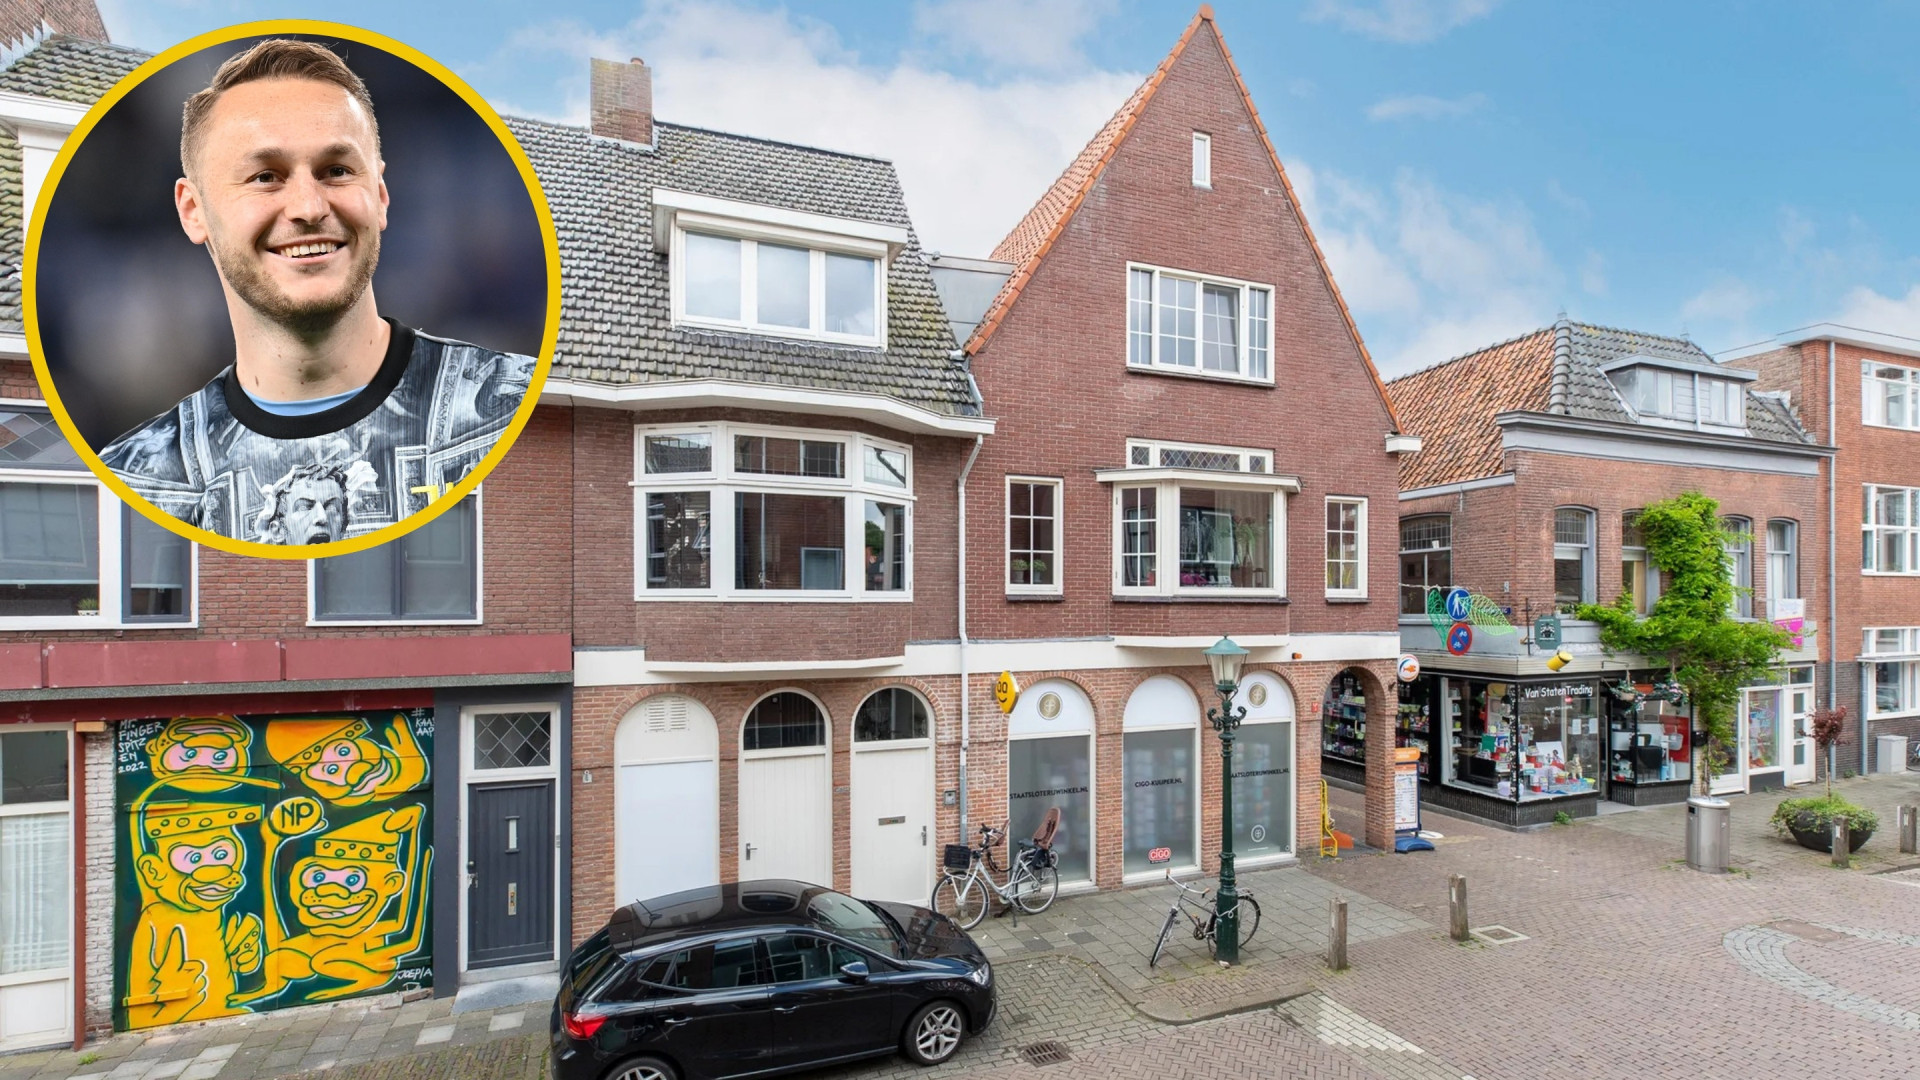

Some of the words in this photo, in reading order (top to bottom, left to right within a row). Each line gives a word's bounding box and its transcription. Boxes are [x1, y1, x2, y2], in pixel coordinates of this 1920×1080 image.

[1525, 687, 1539, 699] Van
[118, 722, 164, 741] FINGER
[118, 752, 137, 763] EN
[118, 761, 148, 774] 2022
[281, 802, 314, 828] NP
